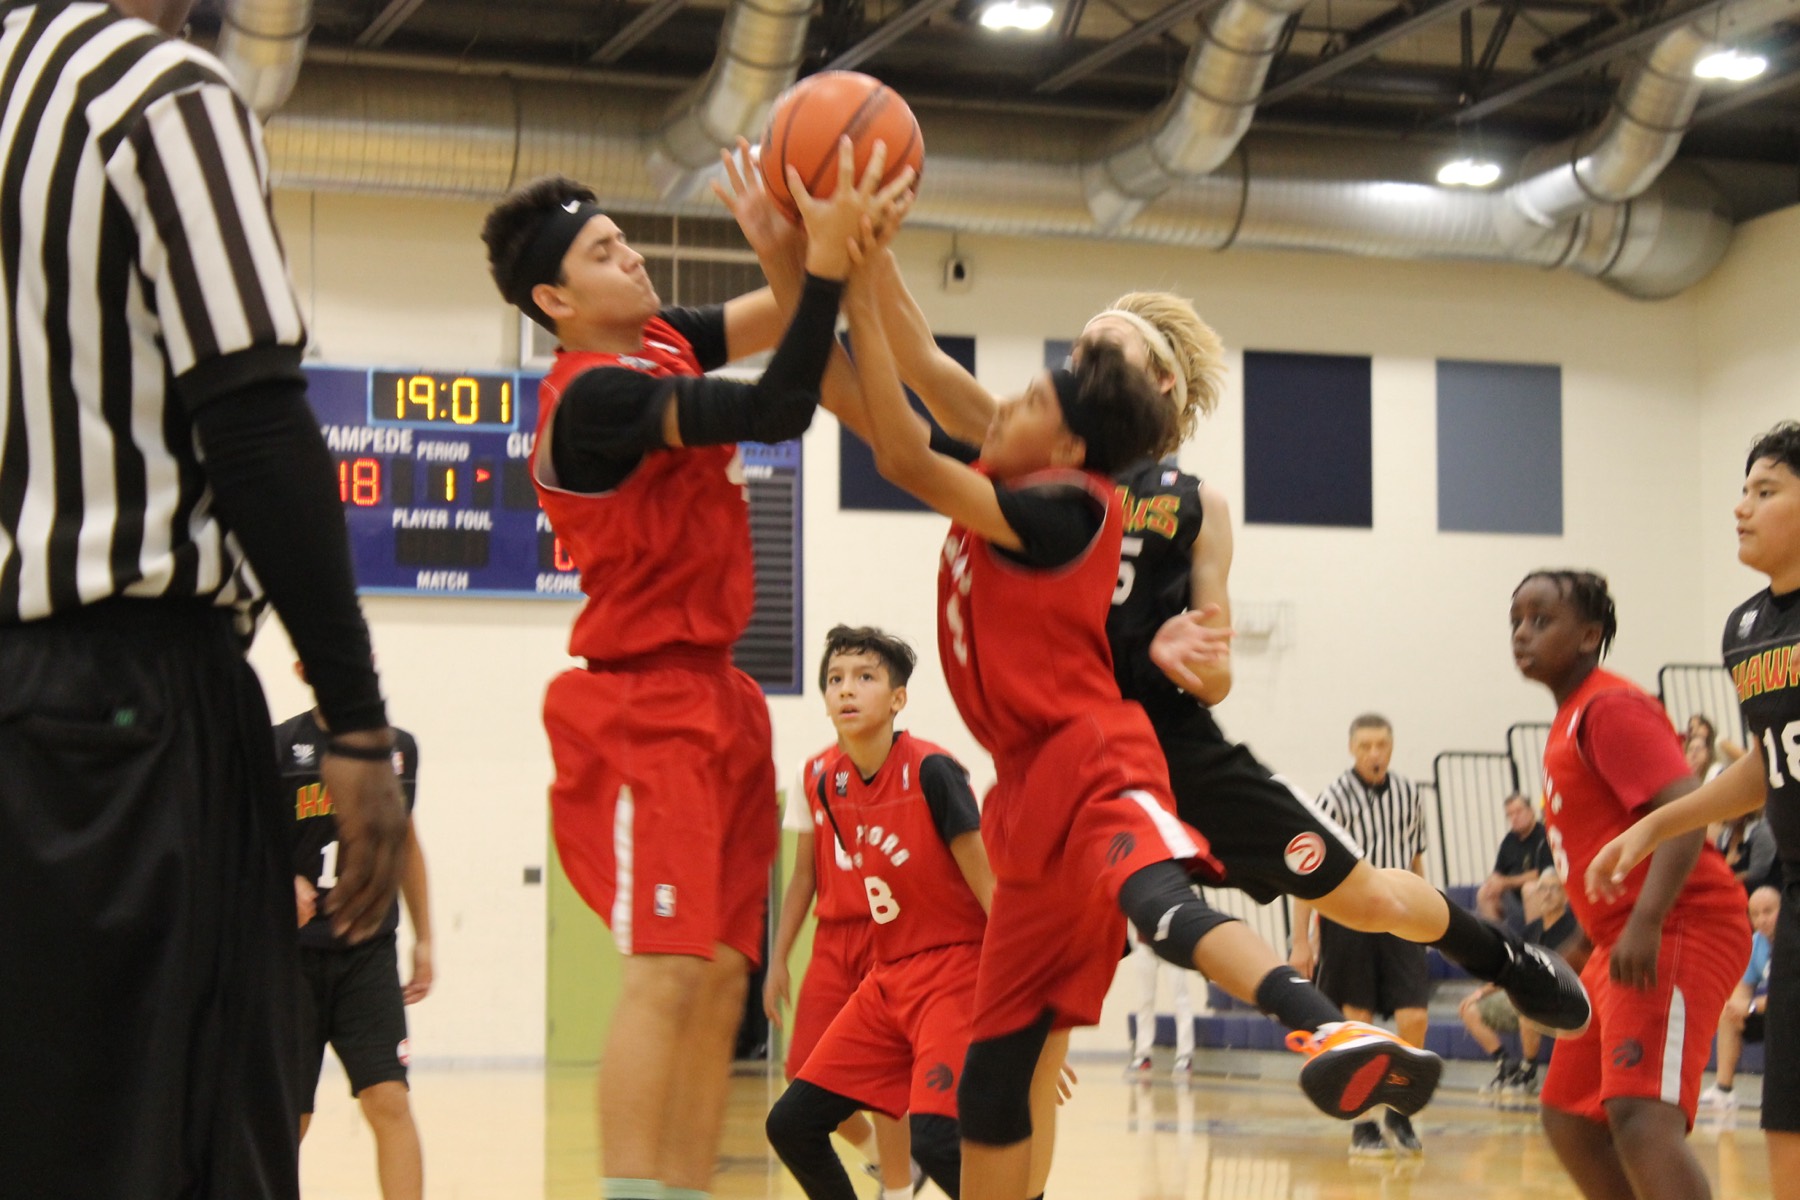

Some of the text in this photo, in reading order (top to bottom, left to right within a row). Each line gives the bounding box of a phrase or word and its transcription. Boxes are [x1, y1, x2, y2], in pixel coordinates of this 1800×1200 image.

[396, 376, 510, 425] 19:01
[321, 425, 414, 454] AMPEDE
[416, 441, 471, 462] PERIOD
[339, 457, 381, 507] 18
[446, 468, 456, 502] 1
[392, 508, 493, 531] PLAYER FOUL
[416, 570, 470, 591] MATCH
[1732, 645, 1800, 704] HAW
